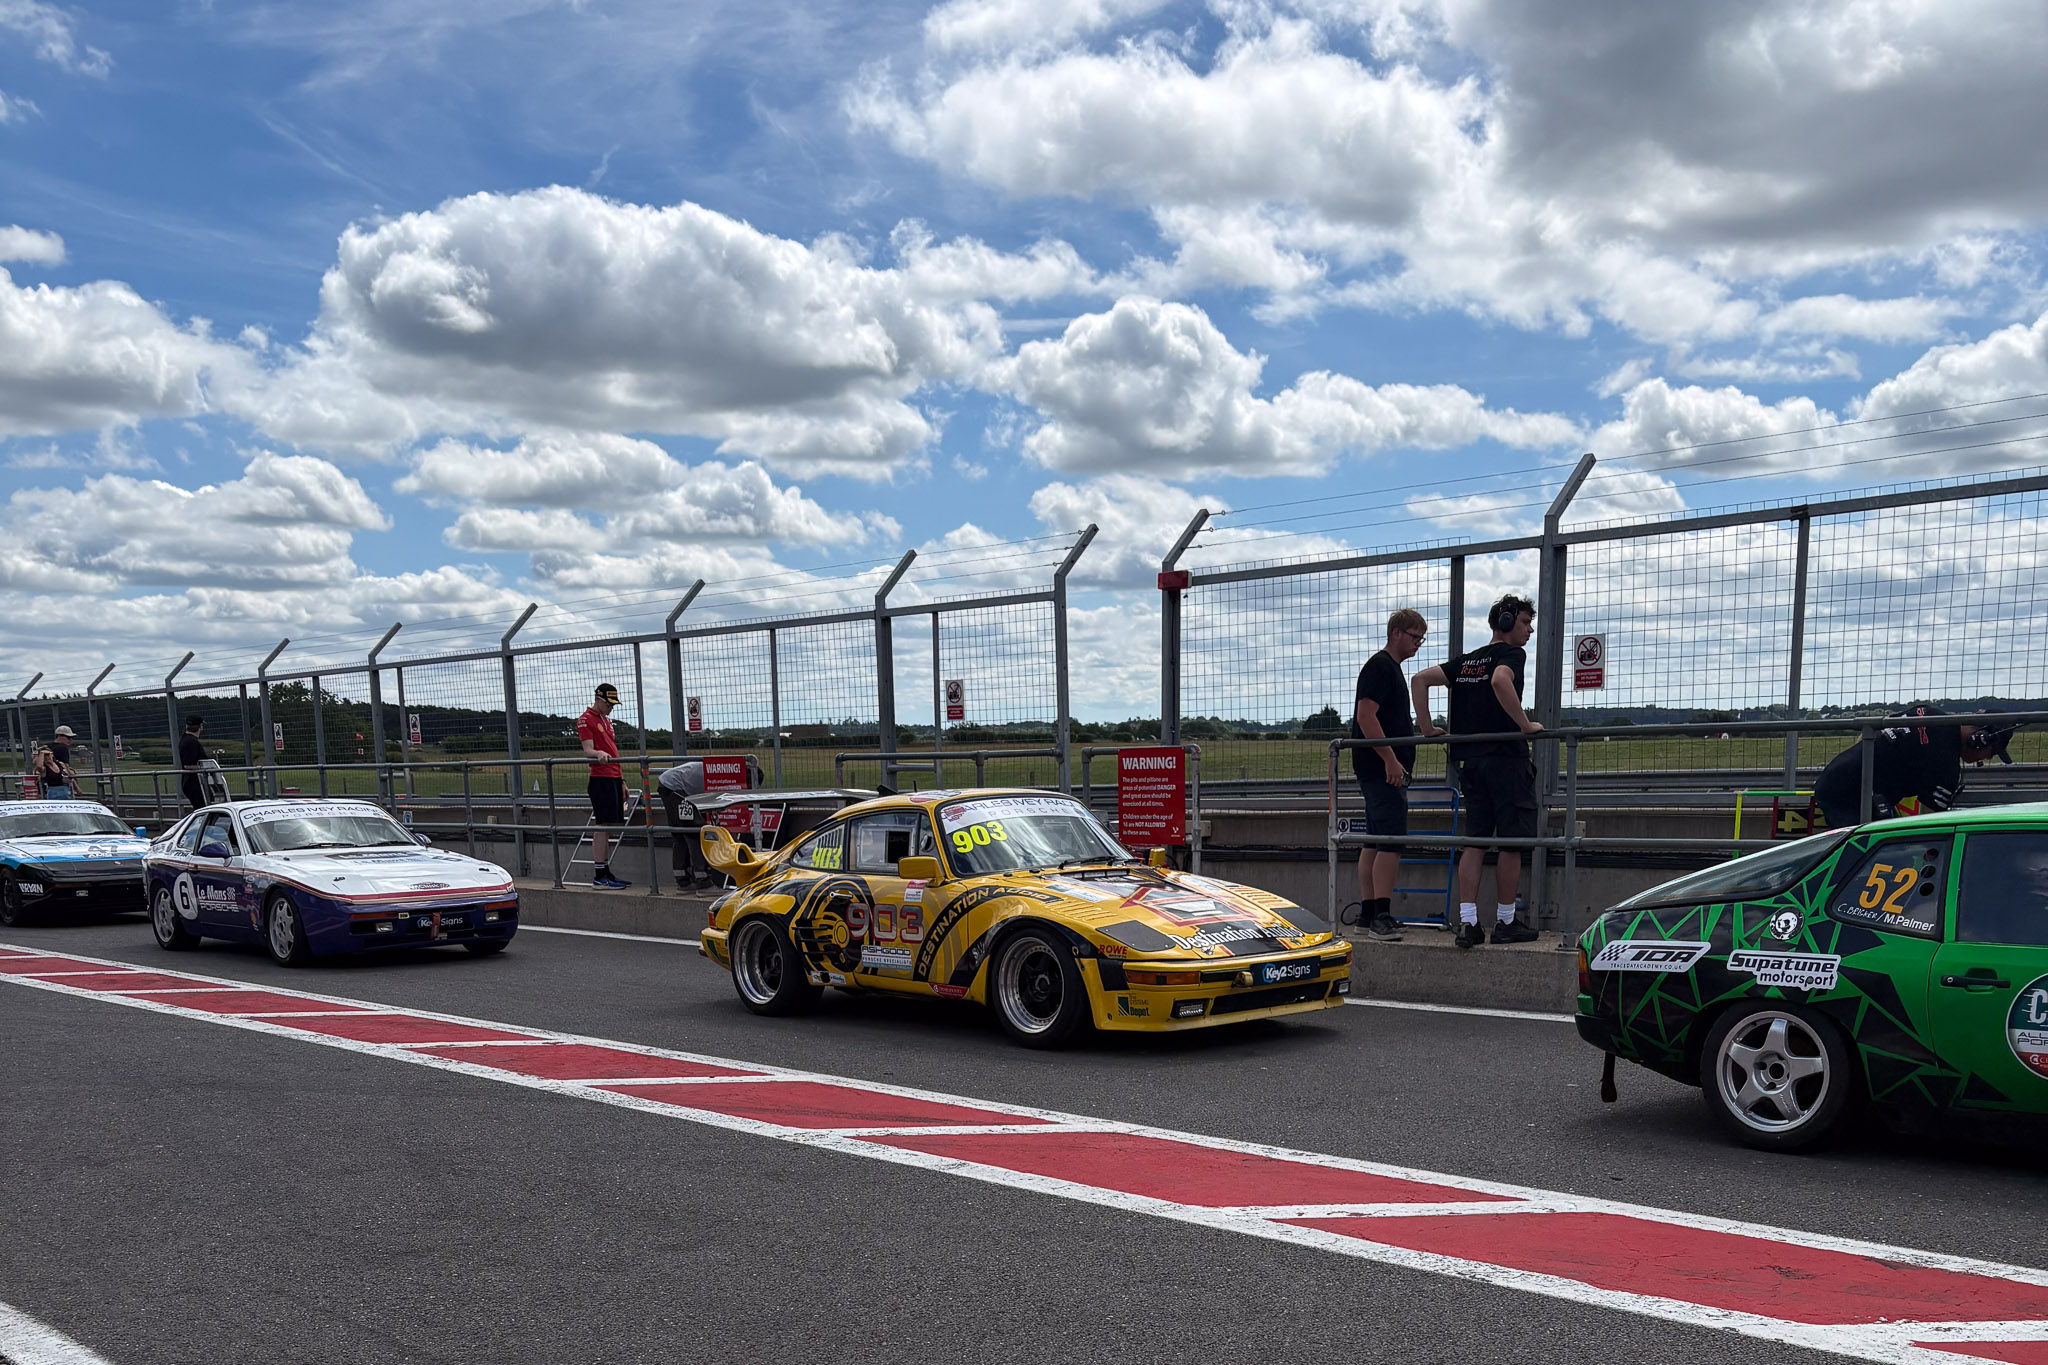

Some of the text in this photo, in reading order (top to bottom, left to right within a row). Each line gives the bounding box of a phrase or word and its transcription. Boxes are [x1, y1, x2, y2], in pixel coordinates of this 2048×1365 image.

[706, 763, 740, 774] WARNING!
[1122, 757, 1176, 770] WARNING!
[1013, 798, 1041, 806] IVEY
[244, 806, 305, 820] CHARLES
[989, 808, 1070, 818] PORSCHE
[952, 821, 1007, 853] 903
[810, 845, 842, 869] 903
[180, 881, 190, 910] 6
[197, 885, 226, 901] Le Mans
[1859, 863, 1918, 914] 52
[200, 902, 239, 912] PORSCHE
[846, 902, 924, 944] 903
[918, 887, 1050, 977] DESTINATION AUDIO
[1165, 922, 1304, 950] Destination Audio
[1099, 944, 1128, 955] ROWE
[1730, 955, 1835, 972] Supatune
[1760, 973, 1834, 988] motorsport
